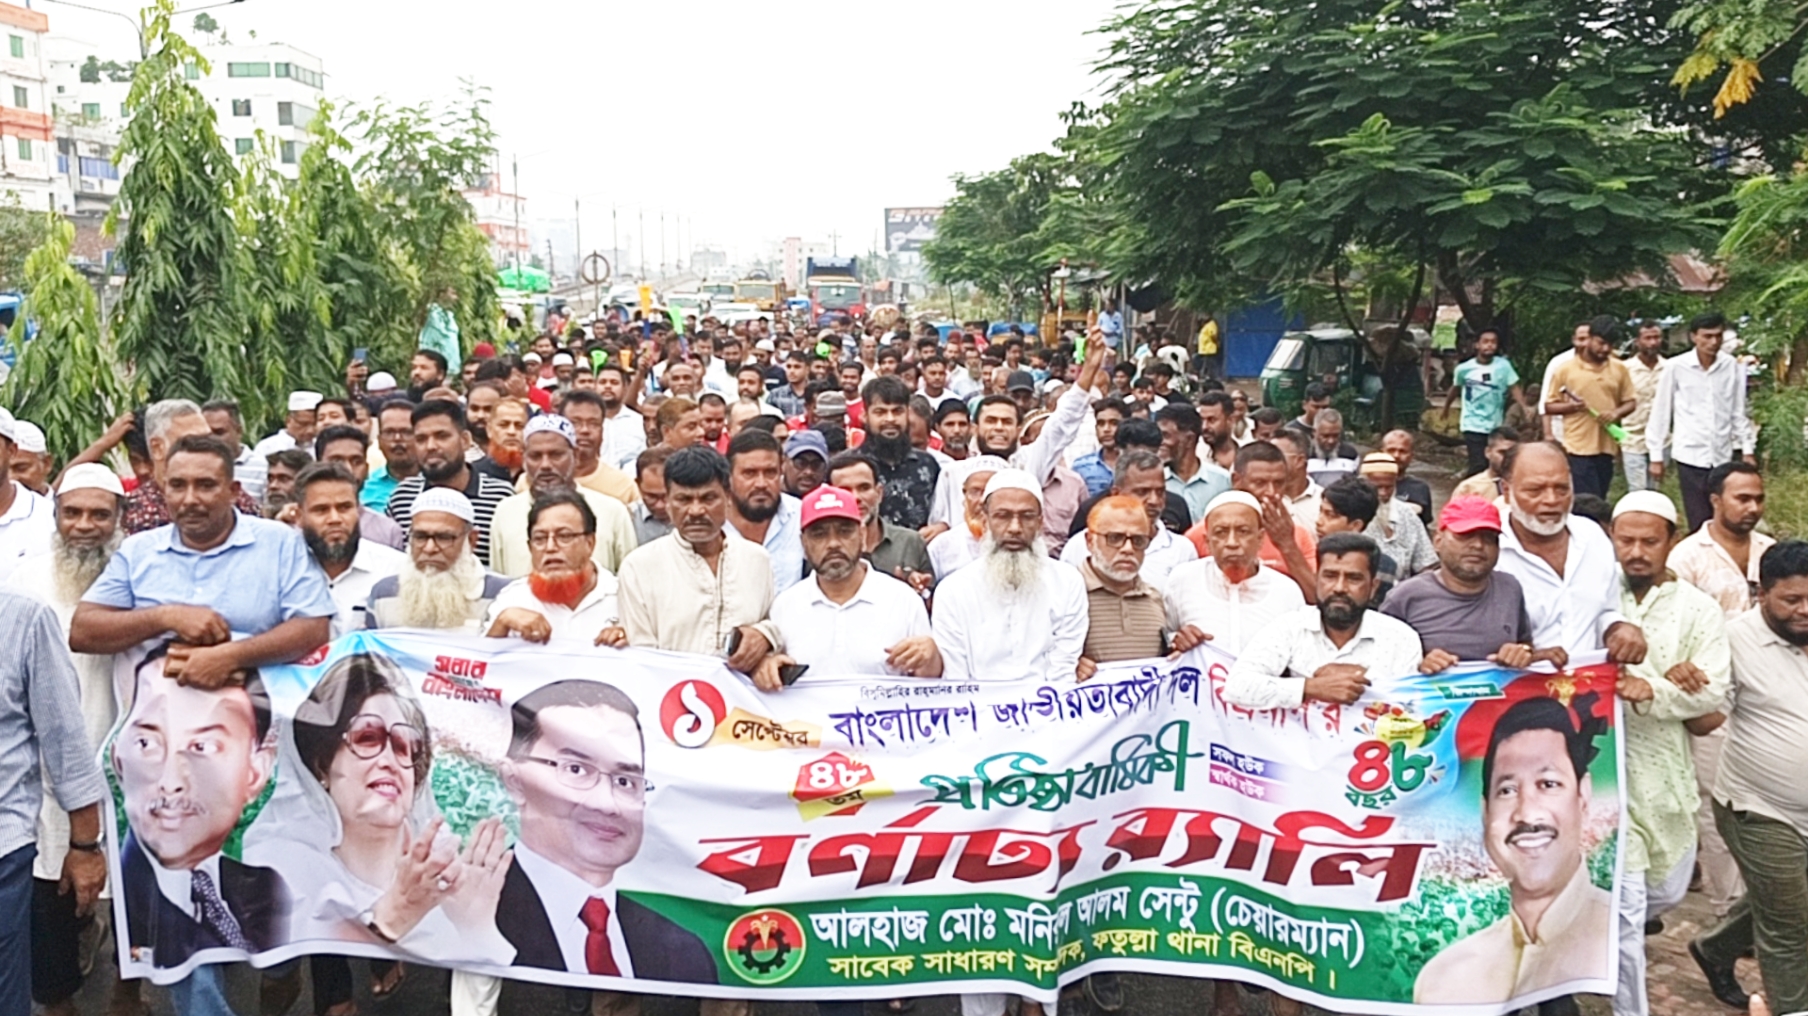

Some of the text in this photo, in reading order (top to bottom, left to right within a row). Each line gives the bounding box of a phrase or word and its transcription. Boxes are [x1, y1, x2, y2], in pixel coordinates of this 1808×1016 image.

[674, 682, 809, 748] ১ সেপ্টেম্বর
[828, 700, 978, 748] বাংলাদেশ
[809, 762, 868, 789] ৪৮
[915, 720, 1205, 812] প্রতিষ্ঠাবার্ষিকী
[1347, 740, 1434, 792] ৪৮
[1345, 785, 1398, 809] বছর
[697, 806, 1097, 894] বর্ণাঢ্য
[809, 906, 929, 951] আলহাজ
[940, 903, 996, 942] মোঃ
[1076, 886, 1131, 926] আলম
[1139, 877, 1203, 933] সেন্টু
[1211, 887, 1365, 969] (চেয়ারম্যান)
[827, 955, 915, 979] সাবেক
[922, 949, 1016, 974] সাধারণ
[1092, 928, 1160, 956] ফতুল্লা
[1166, 930, 1220, 957] থানা
[1226, 932, 1317, 984] বিএনপি
